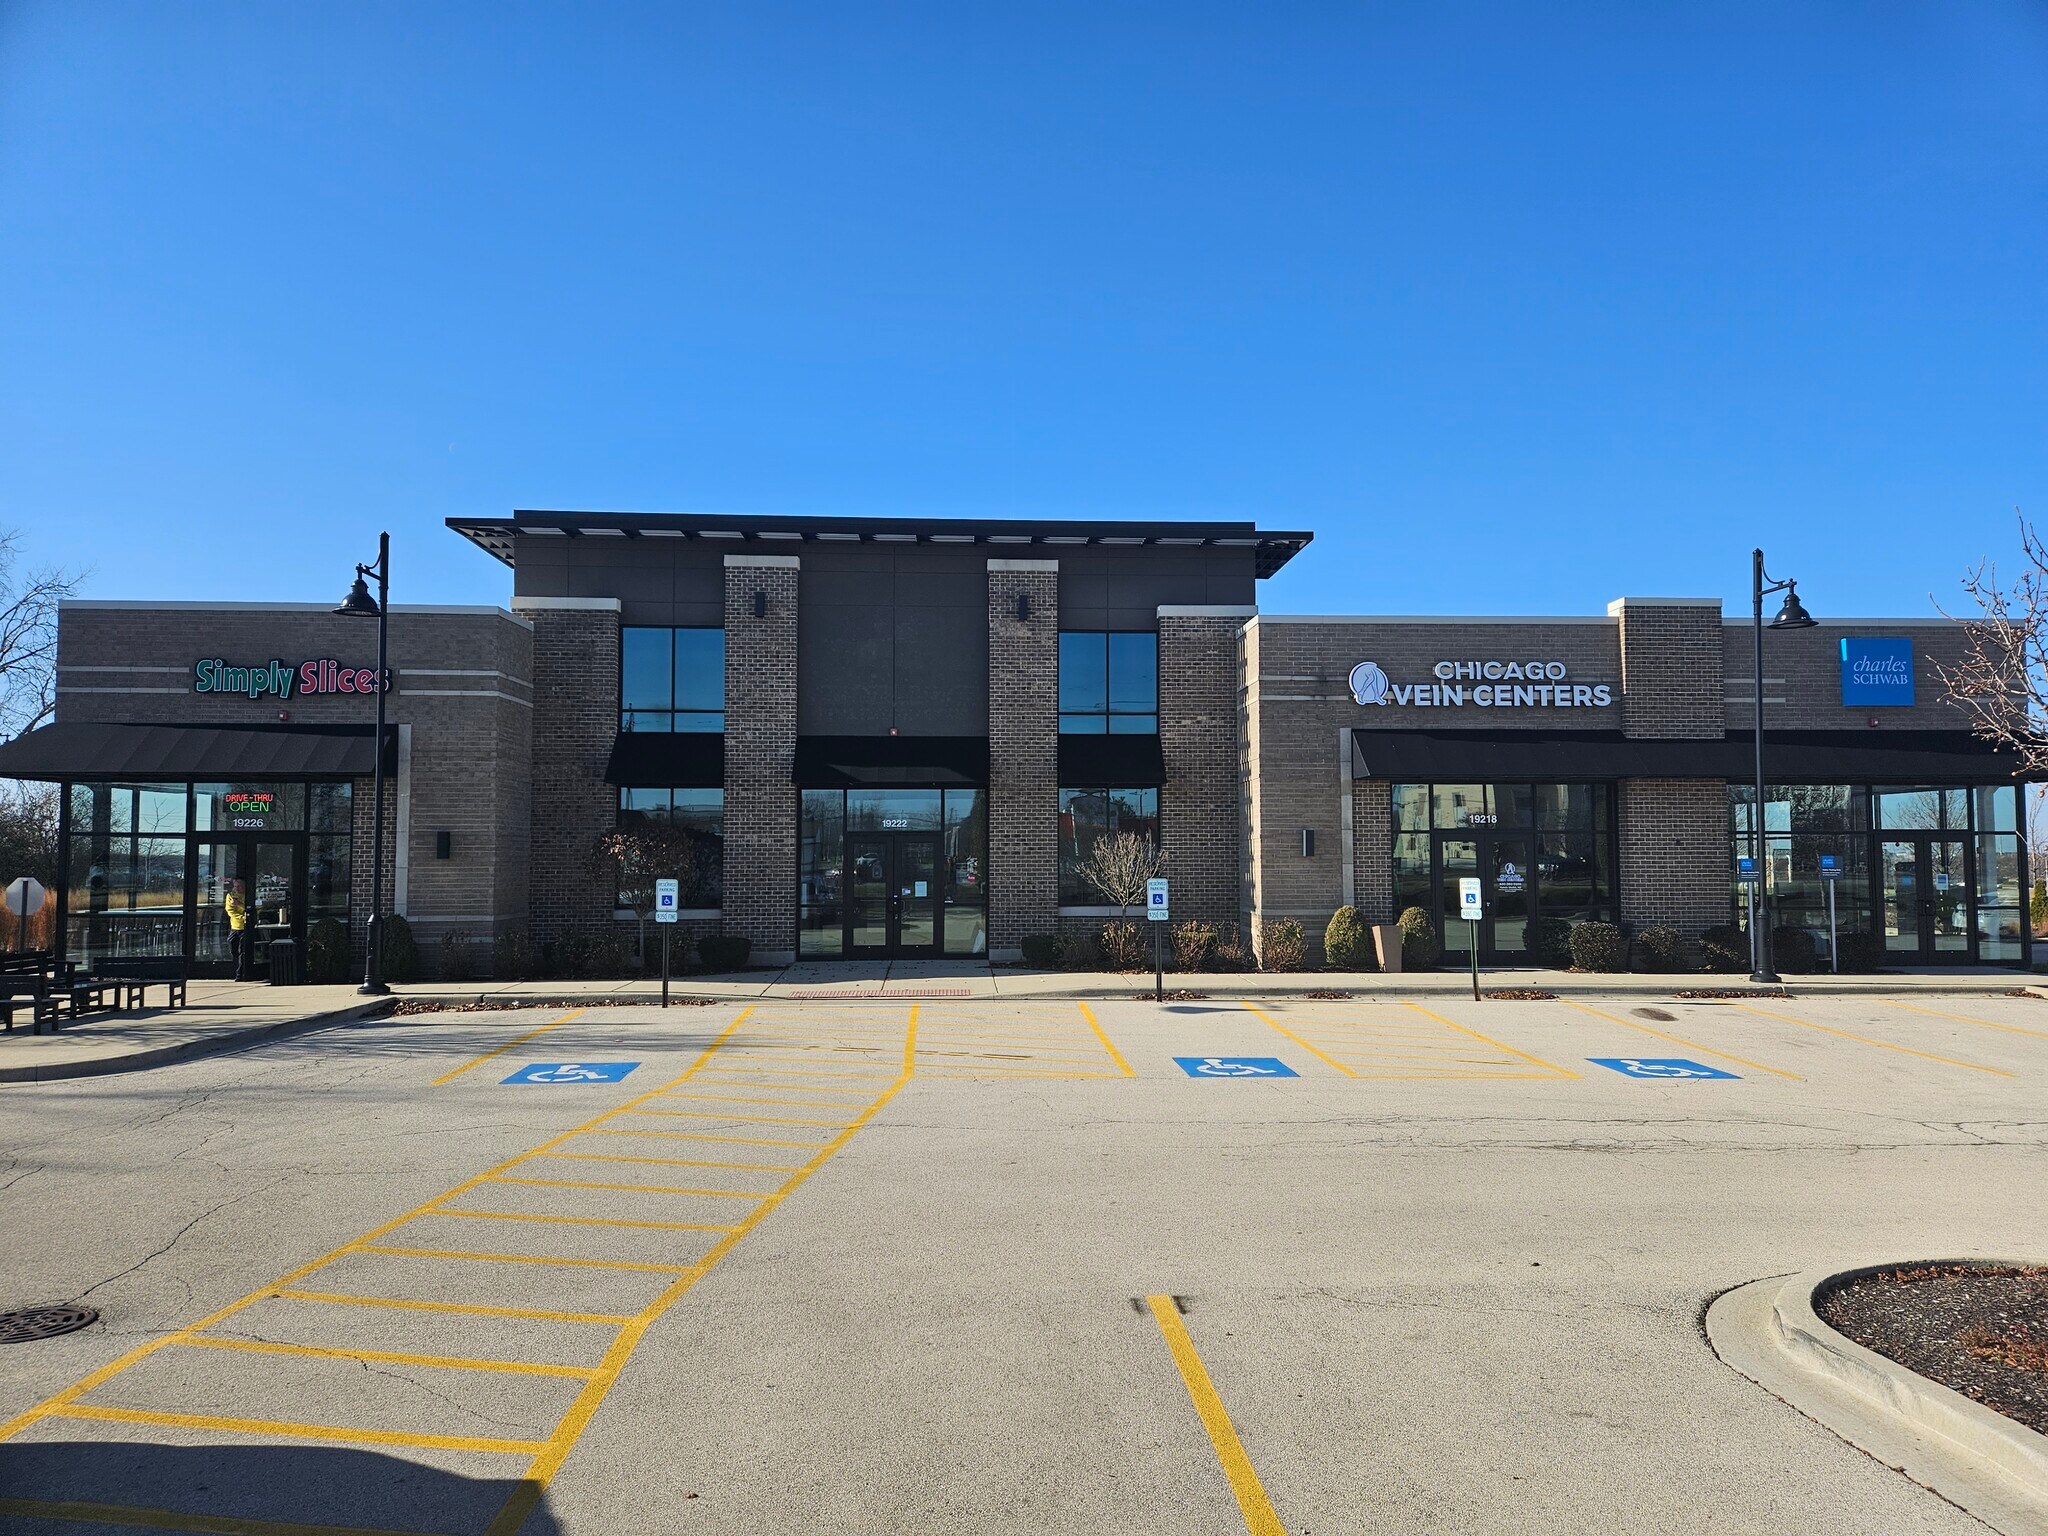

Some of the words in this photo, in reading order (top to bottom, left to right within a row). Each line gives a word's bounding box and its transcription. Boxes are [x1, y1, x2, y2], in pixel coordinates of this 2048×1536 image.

[1853, 655, 1907, 672] charles
[1434, 661, 1567, 680] CHICAGO
[196, 659, 294, 699] Simply
[1853, 673, 1908, 685] SCHWAB
[1391, 684, 1463, 706] VEIN
[1472, 684, 1612, 707] CENTERS
[229, 801, 269, 812] OPEN
[233, 818, 264, 828] 19226
[881, 819, 908, 828] 19222
[1469, 814, 1498, 824] 19218
